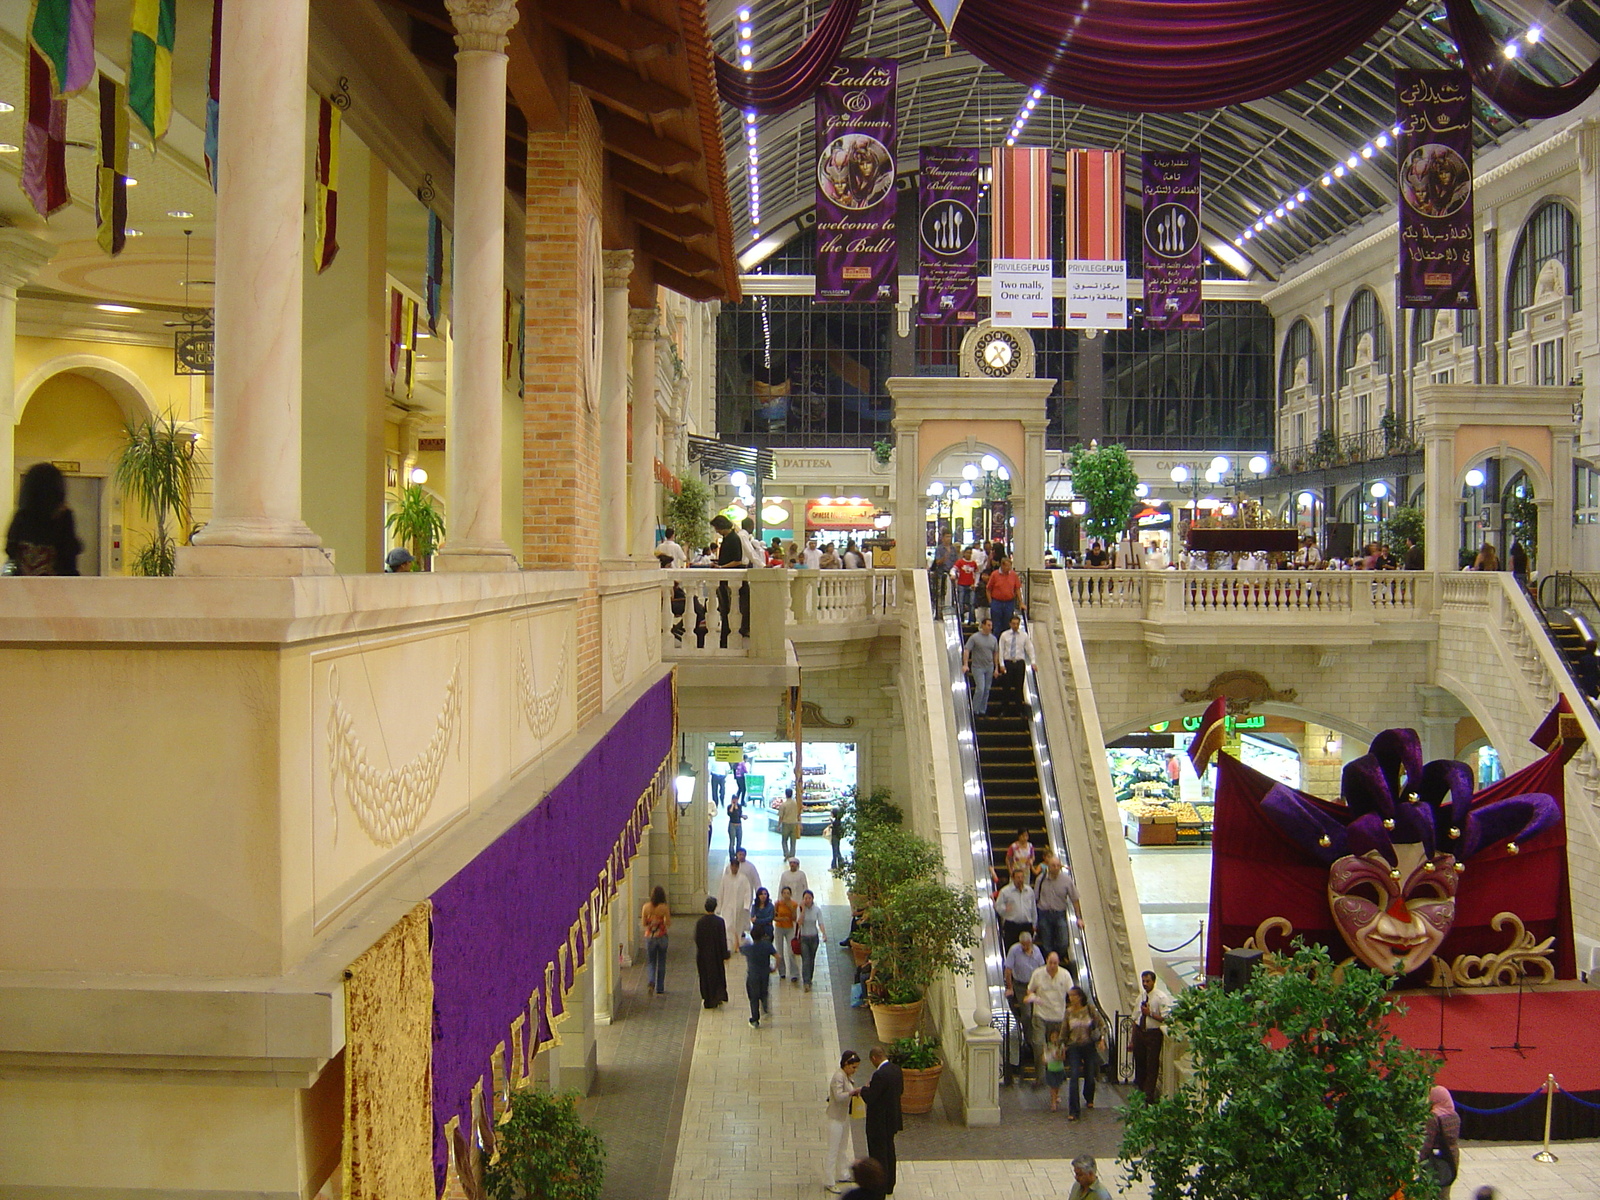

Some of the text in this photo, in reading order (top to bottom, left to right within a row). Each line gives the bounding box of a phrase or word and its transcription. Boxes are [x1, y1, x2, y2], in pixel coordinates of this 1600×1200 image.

[821, 66, 891, 86] Ladies
[1400, 78, 1467, 106] سيداتي
[843, 89, 871, 112] &
[822, 115, 892, 135] Gentlemen,
[1398, 110, 1470, 136] سادتي
[921, 167, 977, 182] Masquerade
[927, 181, 971, 191] Ballroom
[818, 215, 896, 230] welcome to
[820, 234, 896, 253] the Ball!
[1462, 248, 1471, 265] في
[994, 263, 1050, 271] PRIVILEGEPLUS
[1068, 264, 1124, 273] PRIVILEGEPLUS
[1000, 281, 1044, 290] Two malls,
[1001, 292, 1043, 300] One card.
[783, 459, 832, 468] D'ATTESA
